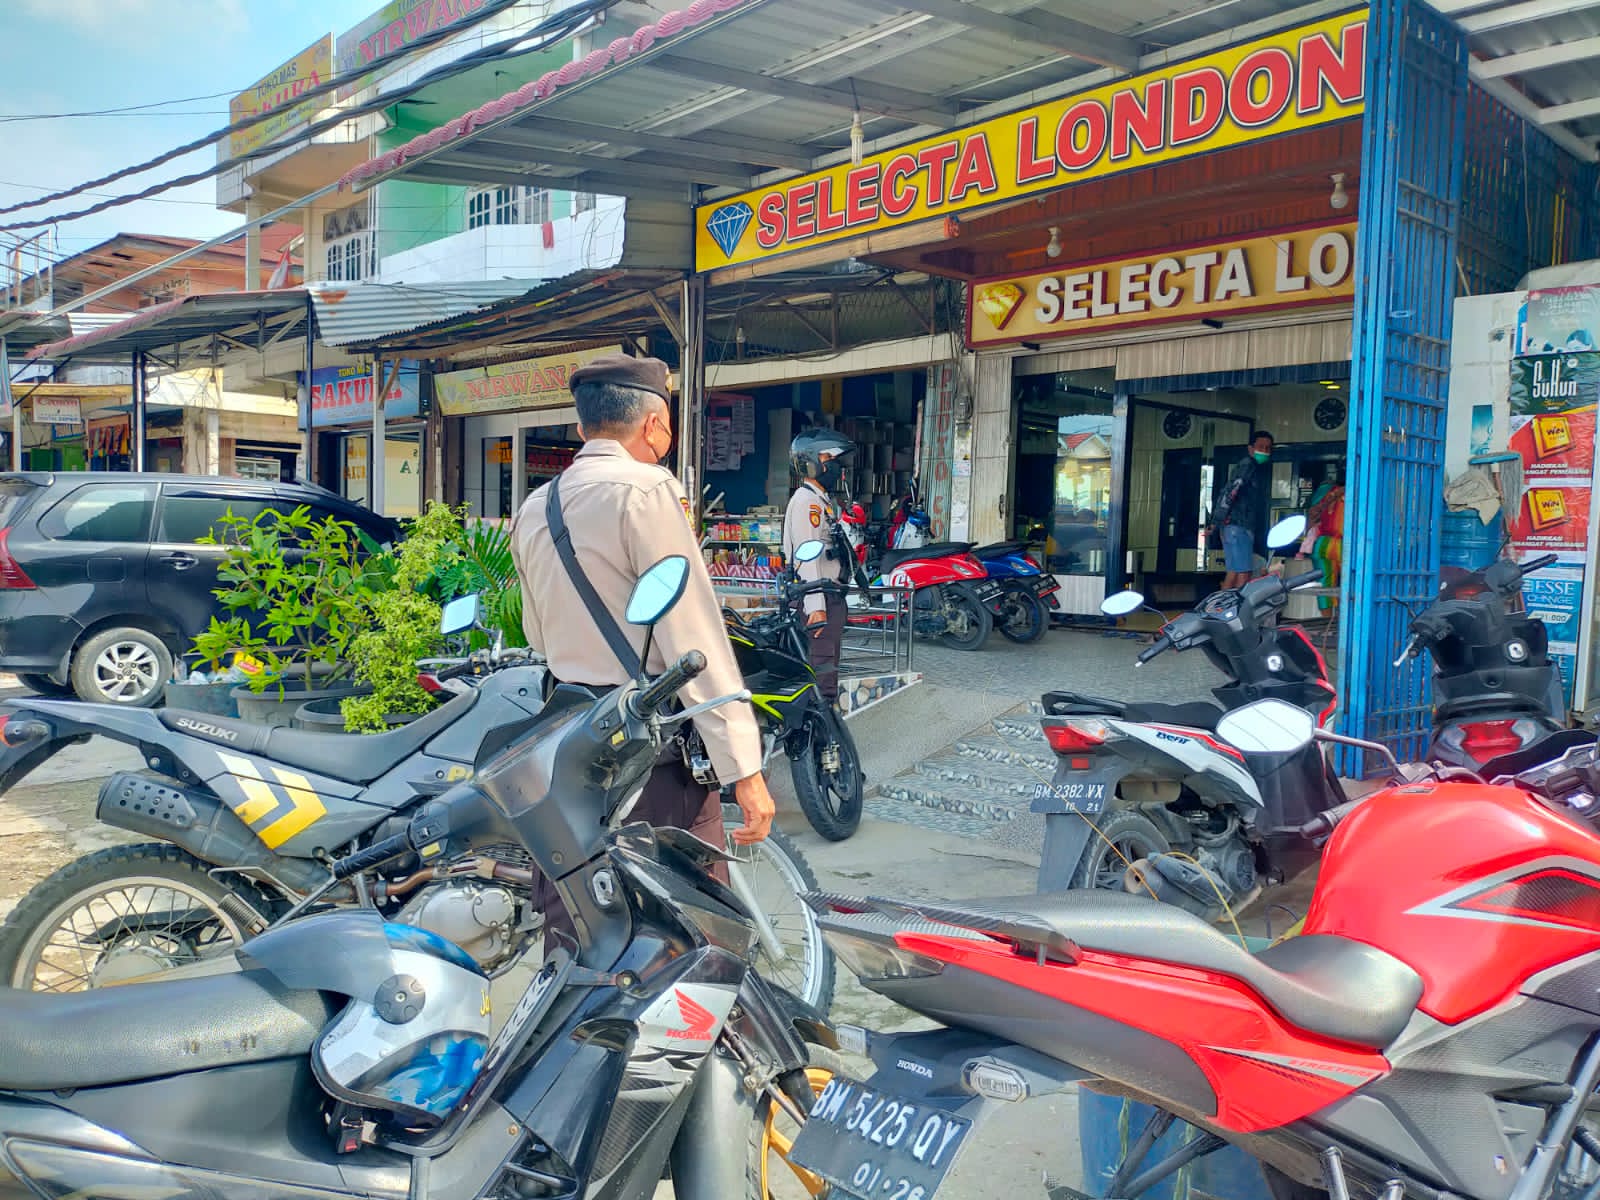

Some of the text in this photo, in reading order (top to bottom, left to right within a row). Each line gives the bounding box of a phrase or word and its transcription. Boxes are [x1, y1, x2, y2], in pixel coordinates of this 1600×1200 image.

[279, 62, 297, 83] MAS
[757, 22, 1368, 248] SELECTA LONDON
[1033, 231, 1358, 324] SELECTA LO
[1535, 579, 1576, 596] ESSE
[176, 718, 239, 742] SUZUKI
[1034, 783, 1105, 799] BM 2382 VX
[664, 1029, 713, 1041] HONDA
[896, 1058, 933, 1079] HONDA
[810, 1079, 961, 1169] BM 5425 QY
